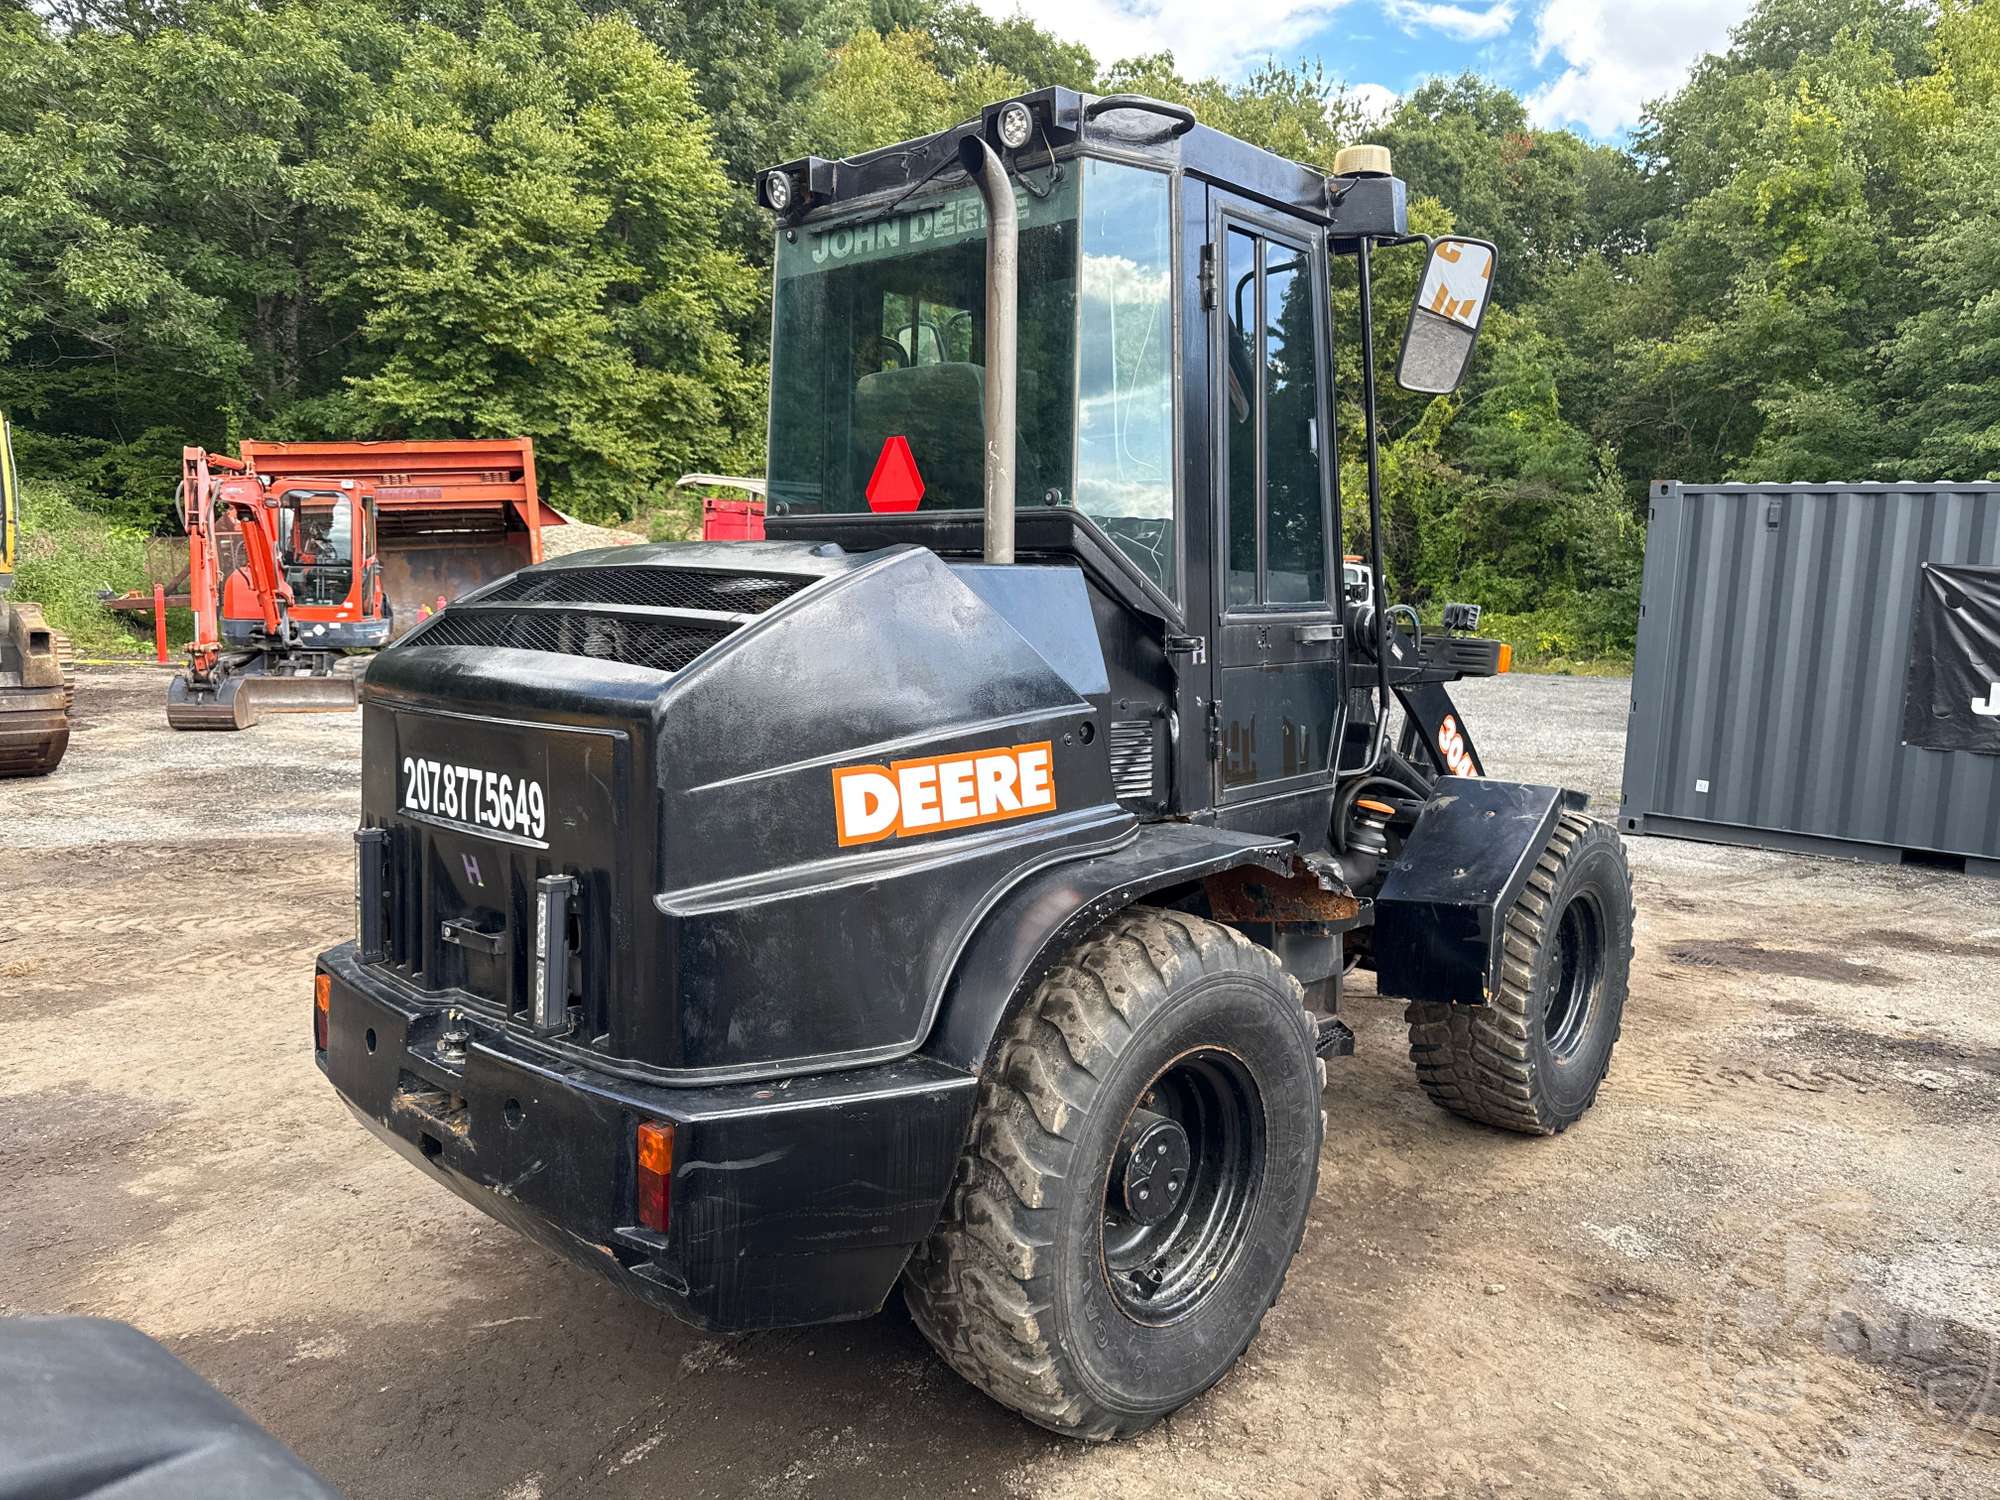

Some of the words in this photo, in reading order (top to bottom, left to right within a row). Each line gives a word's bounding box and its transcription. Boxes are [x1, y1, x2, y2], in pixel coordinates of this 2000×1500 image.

[811, 219, 901, 264] JOHN
[908, 192, 1030, 243] DEEE
[404, 757, 545, 839] 207.877.5649
[840, 749, 1051, 838] DEERE
